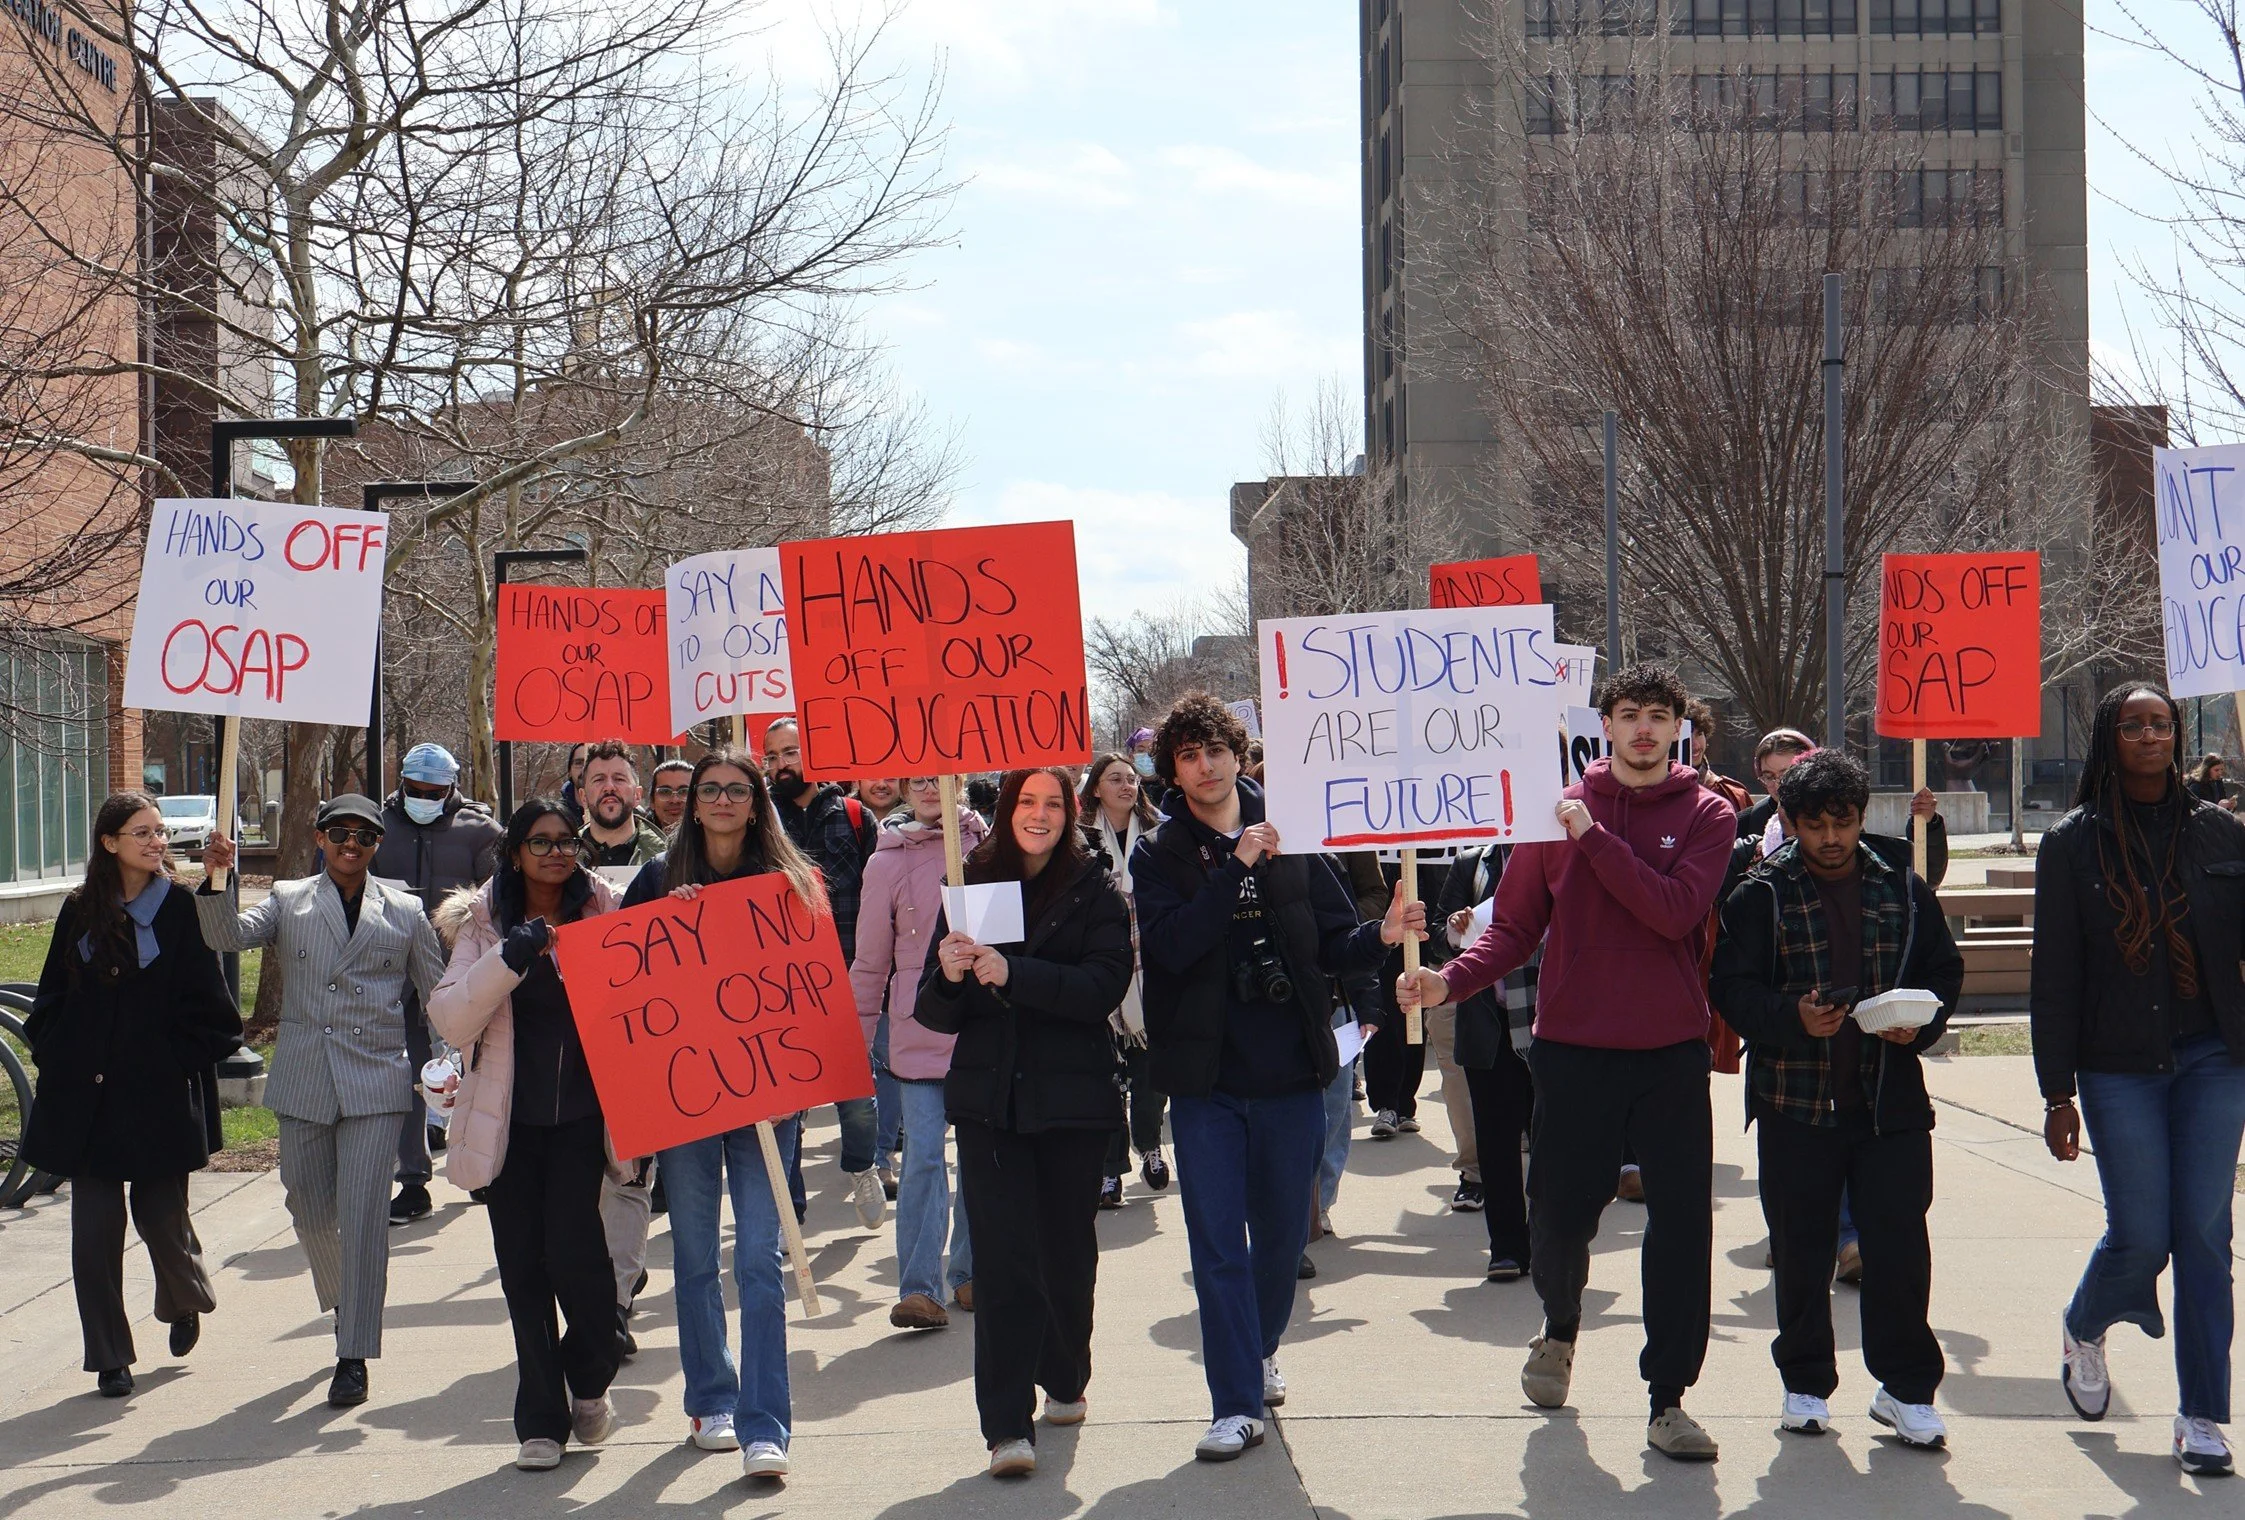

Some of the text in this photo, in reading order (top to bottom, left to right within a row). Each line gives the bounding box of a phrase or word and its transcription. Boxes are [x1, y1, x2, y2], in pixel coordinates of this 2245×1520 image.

[68, 27, 117, 93] CENTRE
[165, 509, 384, 573] HANDS OFF
[2190, 545, 2245, 590] OUR
[205, 578, 257, 610] OUR
[511, 591, 621, 636] HANDS
[680, 562, 736, 623] SAY
[800, 551, 1017, 649] HANDS
[1433, 567, 1525, 608] ANDS
[1884, 565, 2028, 614] NDS OFF
[161, 619, 310, 703] OSAP
[562, 643, 605, 667] OUR
[677, 634, 700, 669] TO
[824, 634, 1053, 691] OFF OUR
[1886, 621, 1939, 649] OUR
[515, 666, 652, 731] OSAP
[695, 669, 787, 712] CUTS
[803, 686, 1086, 771] EDUCATION
[1303, 704, 1504, 765] ARE OUR
[1325, 769, 1514, 839] FUTURE!
[602, 888, 815, 988] SAY NO
[610, 961, 833, 1045] TO OSAP
[668, 1026, 822, 1117] CUTS
